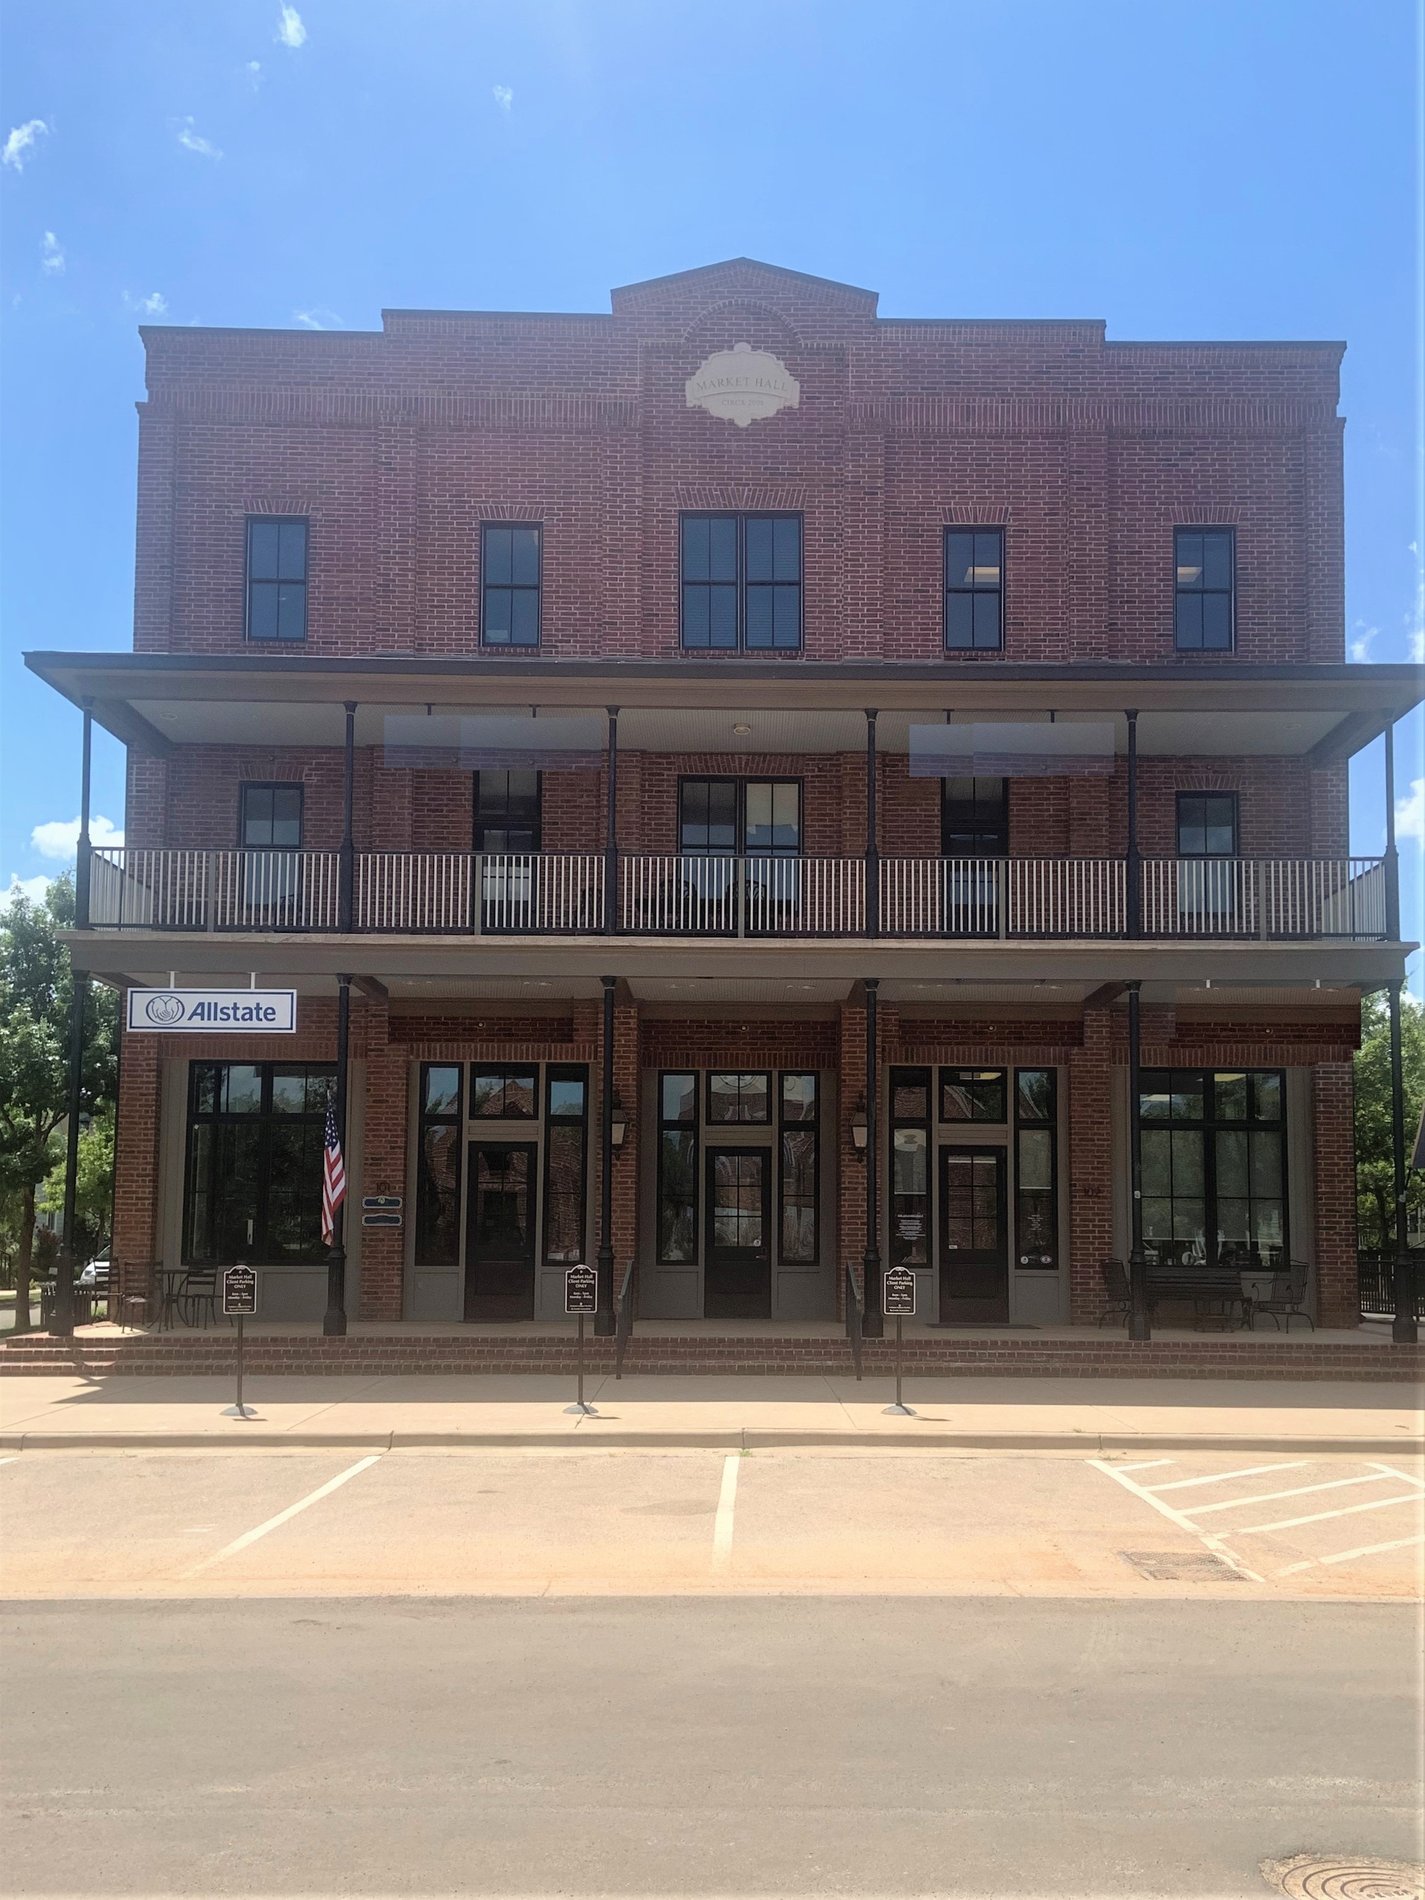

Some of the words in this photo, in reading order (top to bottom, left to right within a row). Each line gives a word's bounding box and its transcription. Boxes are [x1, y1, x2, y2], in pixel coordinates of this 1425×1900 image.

[696, 376, 750, 391] MARKET
[755, 377, 788, 391] HALL
[187, 1002, 276, 1022] Allstate
